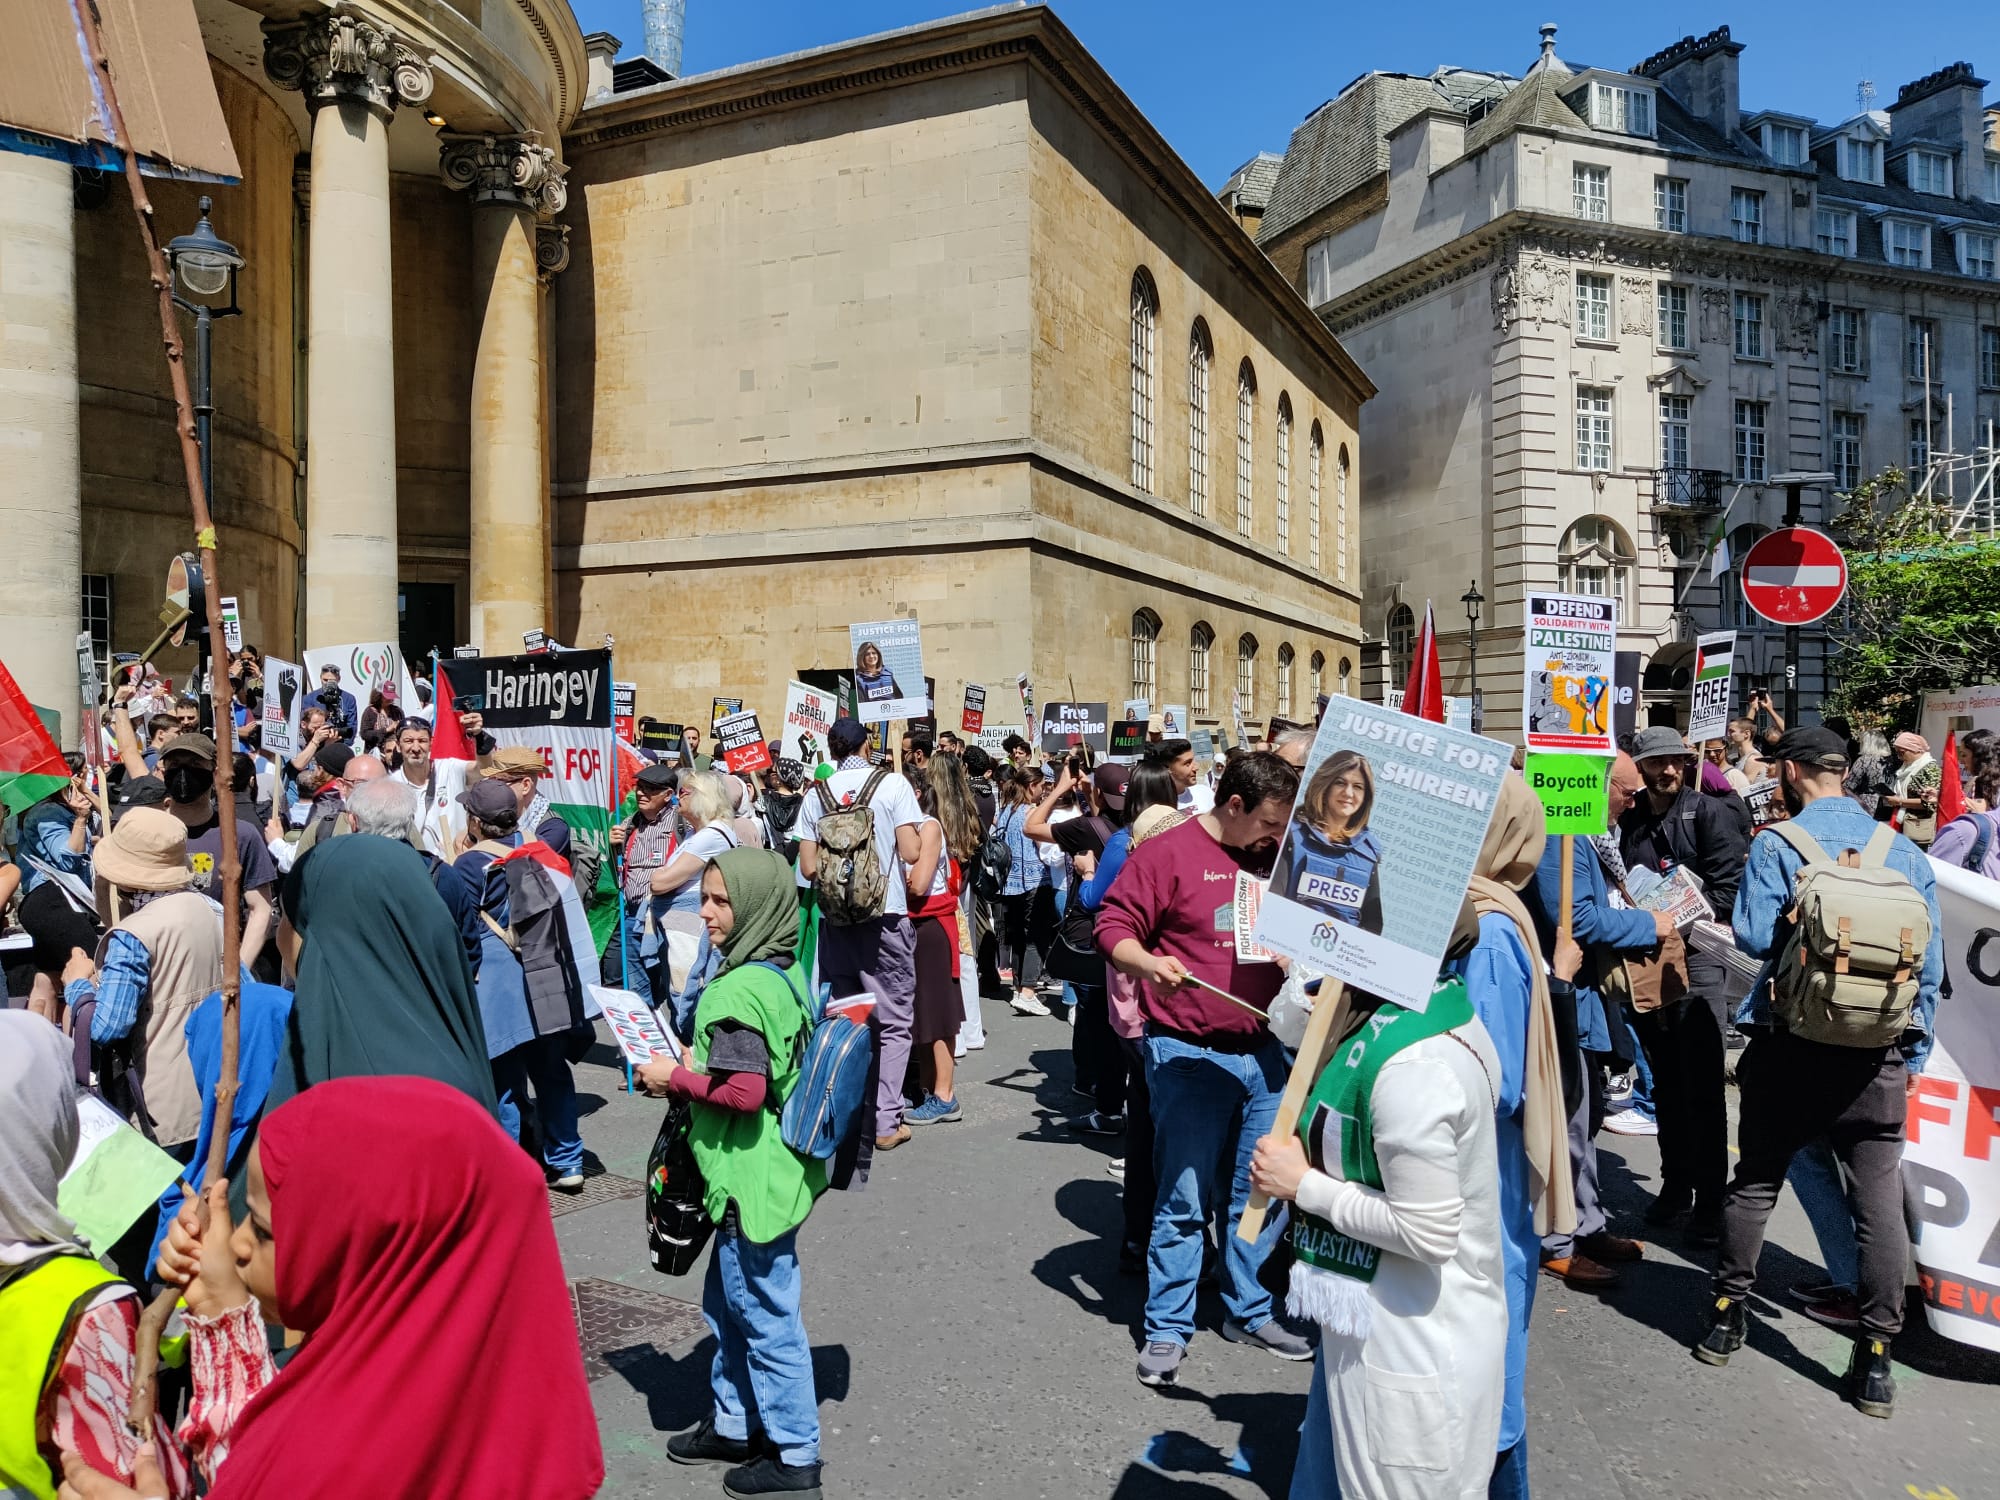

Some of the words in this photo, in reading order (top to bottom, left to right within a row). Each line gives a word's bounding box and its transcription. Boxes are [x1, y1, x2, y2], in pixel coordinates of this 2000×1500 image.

[1545, 599, 1604, 619] DEFEND
[857, 626, 894, 636] JUSTICE
[897, 623, 917, 633] FOR
[1534, 617, 1587, 630] SOLIDARITY
[1589, 622, 1610, 631] WITH
[879, 636, 918, 647] SHIREEN
[1532, 630, 1611, 651] PALESTINE
[485, 663, 598, 720] Haringey
[614, 690, 632, 701] DOM
[805, 693, 821, 709] END
[872, 686, 892, 697] PRESS
[1693, 678, 1729, 709] FREE
[796, 702, 826, 722] ISRAELI
[1060, 705, 1089, 719] Free
[1692, 703, 1727, 722] PALESTINE
[720, 717, 756, 737] FREEDOM
[1044, 720, 1105, 734] Palestine
[722, 730, 762, 751] PALESTINE
[978, 740, 1000, 748] PLACE
[1340, 712, 1439, 757] JUSTICE
[1443, 741, 1499, 778] FOR
[1380, 761, 1489, 812] SHIREEN
[1533, 772, 1598, 792] Boycott
[1376, 802, 1401, 816] FREE
[1402, 811, 1460, 837] PALESTINE
[1541, 802, 1591, 817] srael!
[1372, 815, 1397, 829] FREE
[1398, 824, 1456, 850] PALESTINE
[1393, 836, 1450, 862] PALESTINE
[1308, 878, 1360, 903] PRESS
[1238, 877, 1249, 925] RACISM!
[1679, 901, 1705, 924] FIGHT
[1239, 925, 1251, 956] FIGHT
[1341, 939, 1365, 954] Muslim
[1308, 955, 1324, 967] STAY
[1324, 962, 1352, 977] UPDATED
[1339, 946, 1377, 966] Association
[1293, 1221, 1376, 1269] PALESTINE
